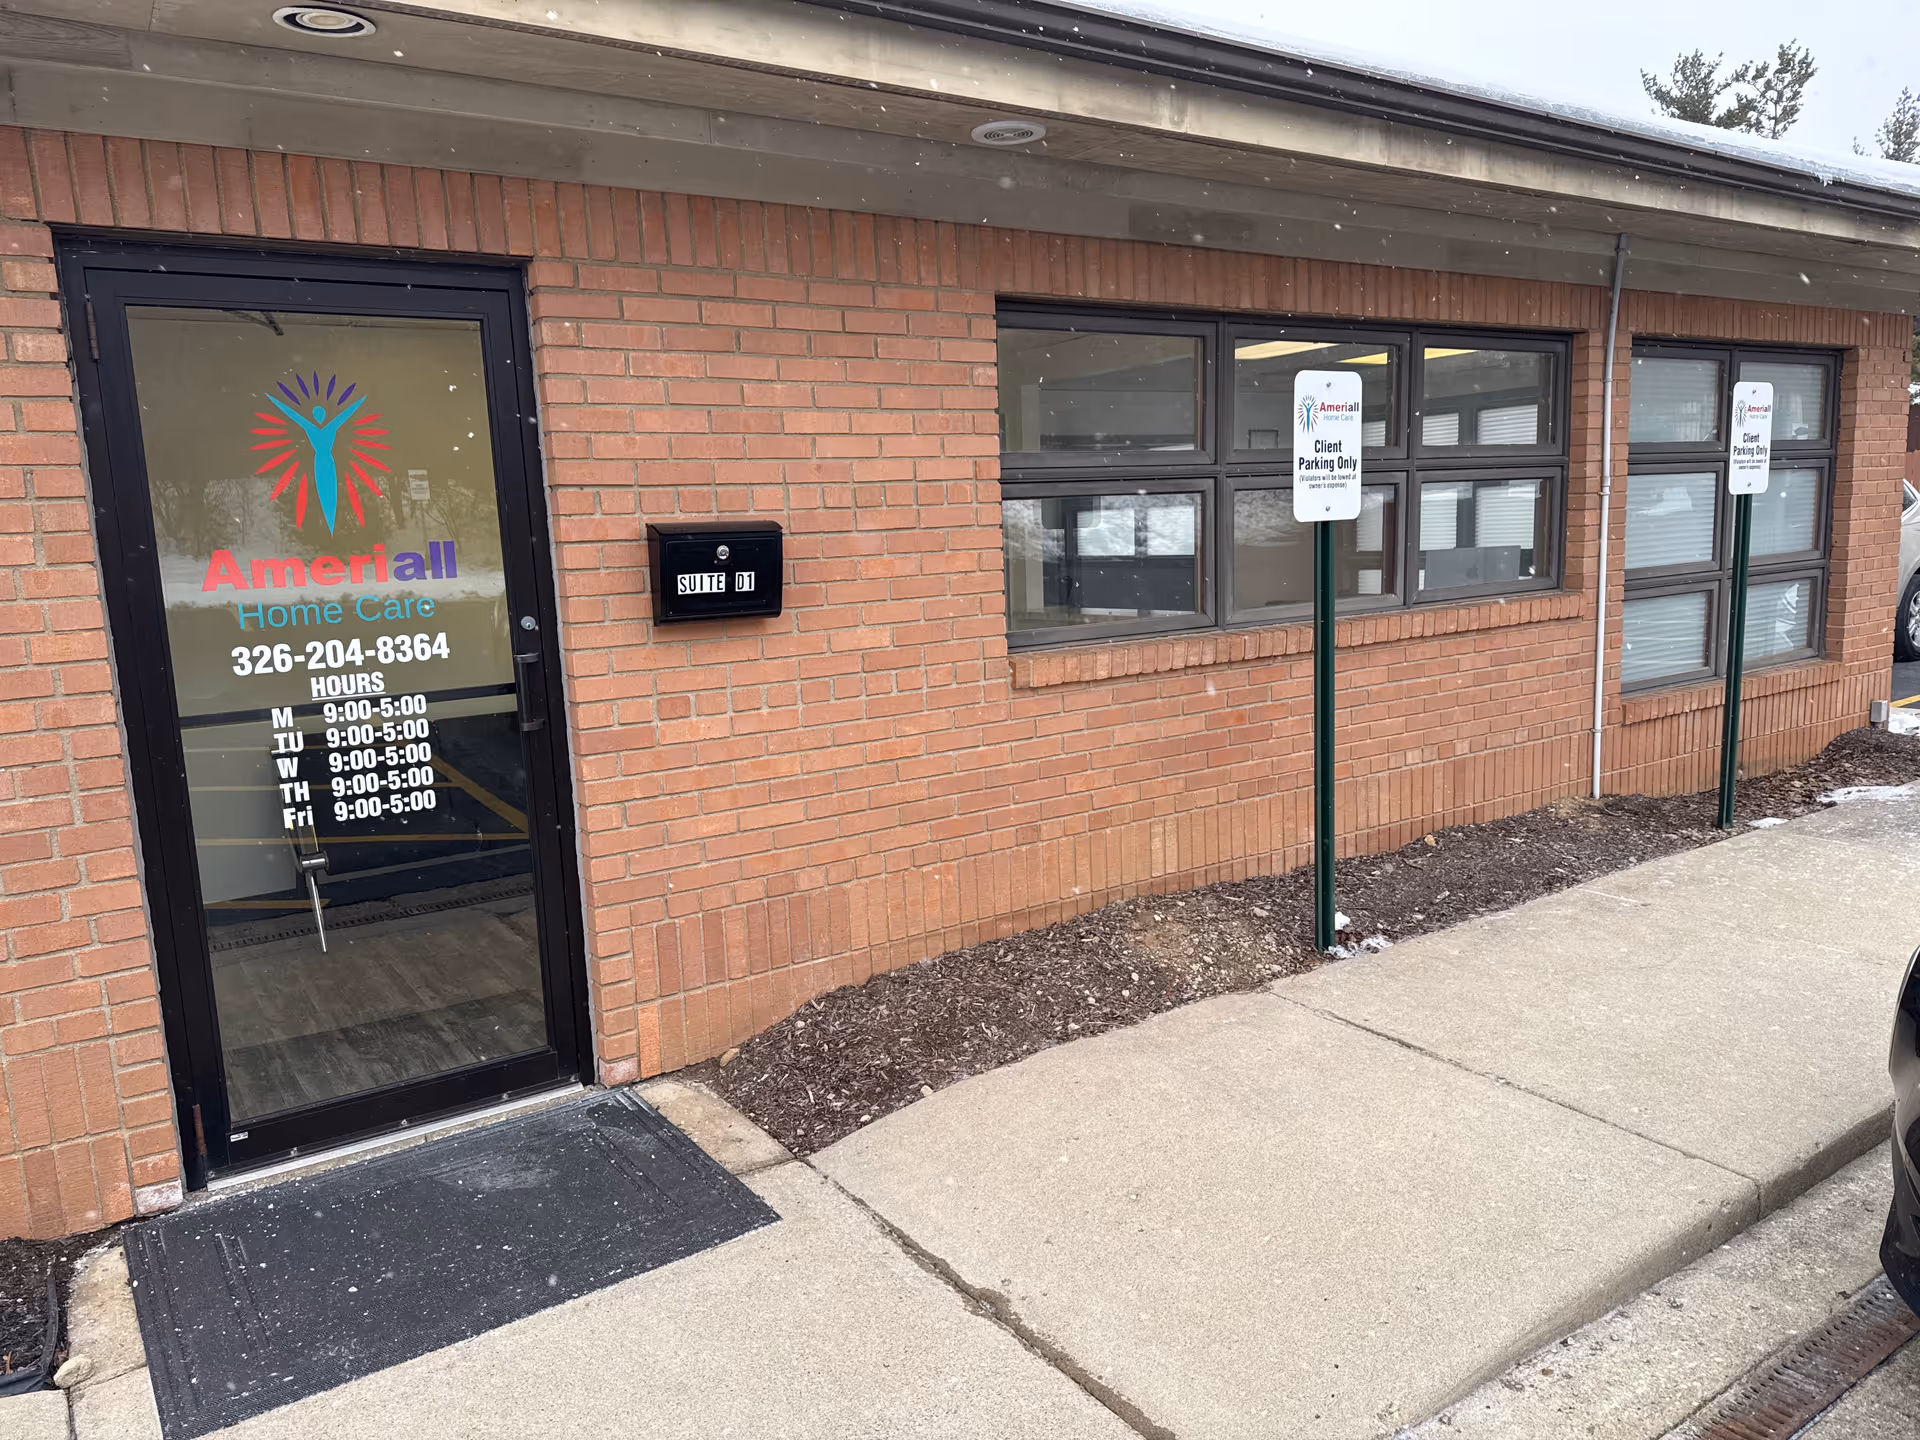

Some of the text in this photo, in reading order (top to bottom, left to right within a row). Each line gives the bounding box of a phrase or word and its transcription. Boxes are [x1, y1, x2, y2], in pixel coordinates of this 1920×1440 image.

[1319, 401, 1360, 412] Ameriall
[1747, 404, 1771, 413] Ameriall
[1340, 413, 1354, 421] Care
[1314, 439, 1342, 453] Client
[1743, 432, 1760, 443] Client
[1733, 445, 1768, 457] Parking Only
[1299, 456, 1357, 472] Parking Only
[1299, 474, 1321, 483] (Violators
[1327, 481, 1347, 490] expense)
[202, 540, 458, 592] Ameriall
[679, 574, 724, 593] SUITE
[237, 595, 435, 630] Home Care
[231, 632, 450, 676] 326-204-8364
[310, 671, 385, 698] HOURS
[271, 694, 427, 729] M 9:00-5:00
[274, 718, 430, 754] TU 9:00-5:00
[276, 741, 432, 779] W 9:00-5:00
[280, 765, 435, 804] TH 9:00-5:00
[283, 789, 437, 829] Fri 9:00-5:00
